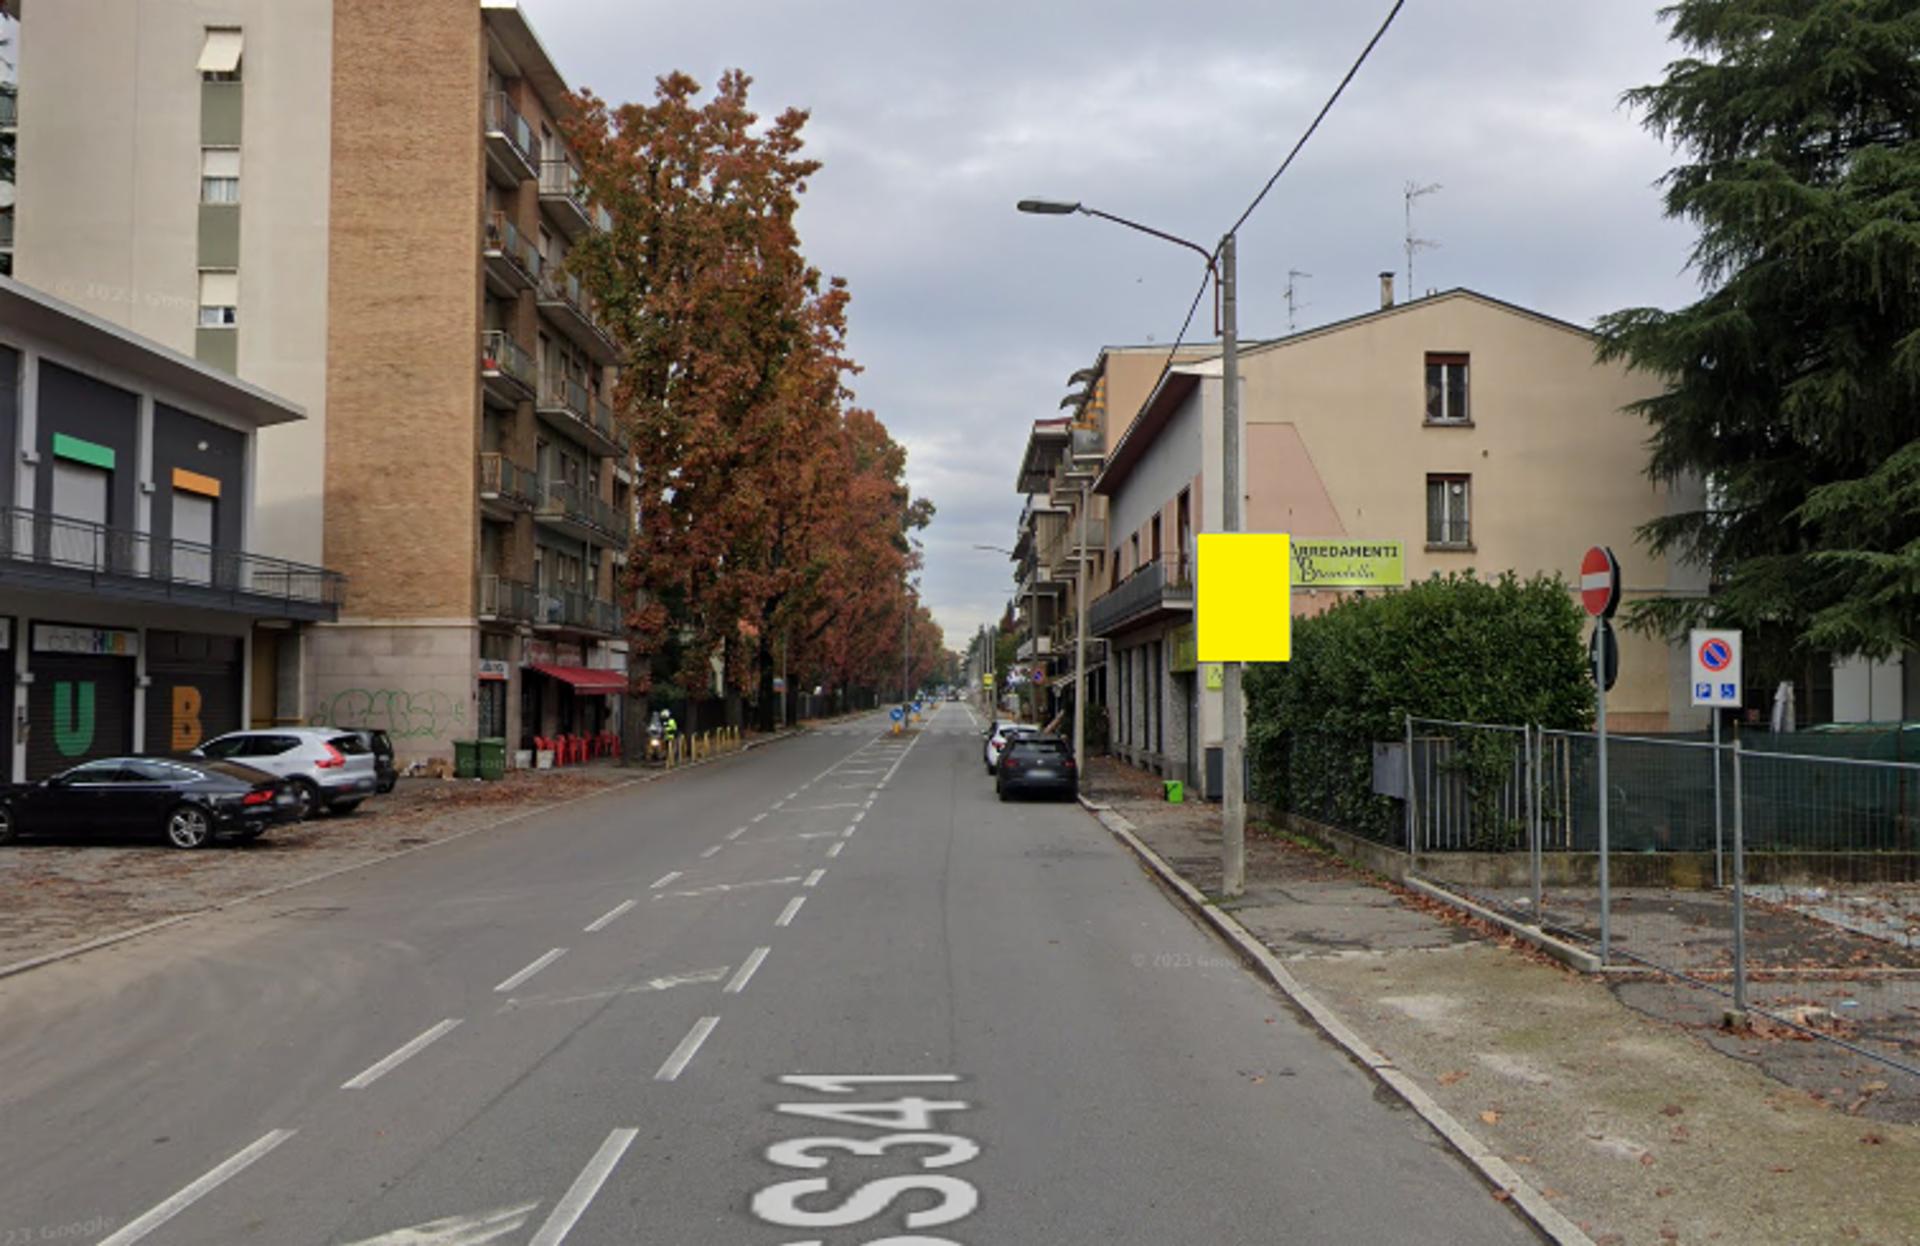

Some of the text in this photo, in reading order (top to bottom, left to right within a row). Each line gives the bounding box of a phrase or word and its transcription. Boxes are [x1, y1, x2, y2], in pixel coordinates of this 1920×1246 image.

[53, 683, 202, 755] U B
[752, 1075, 980, 1246] S341
